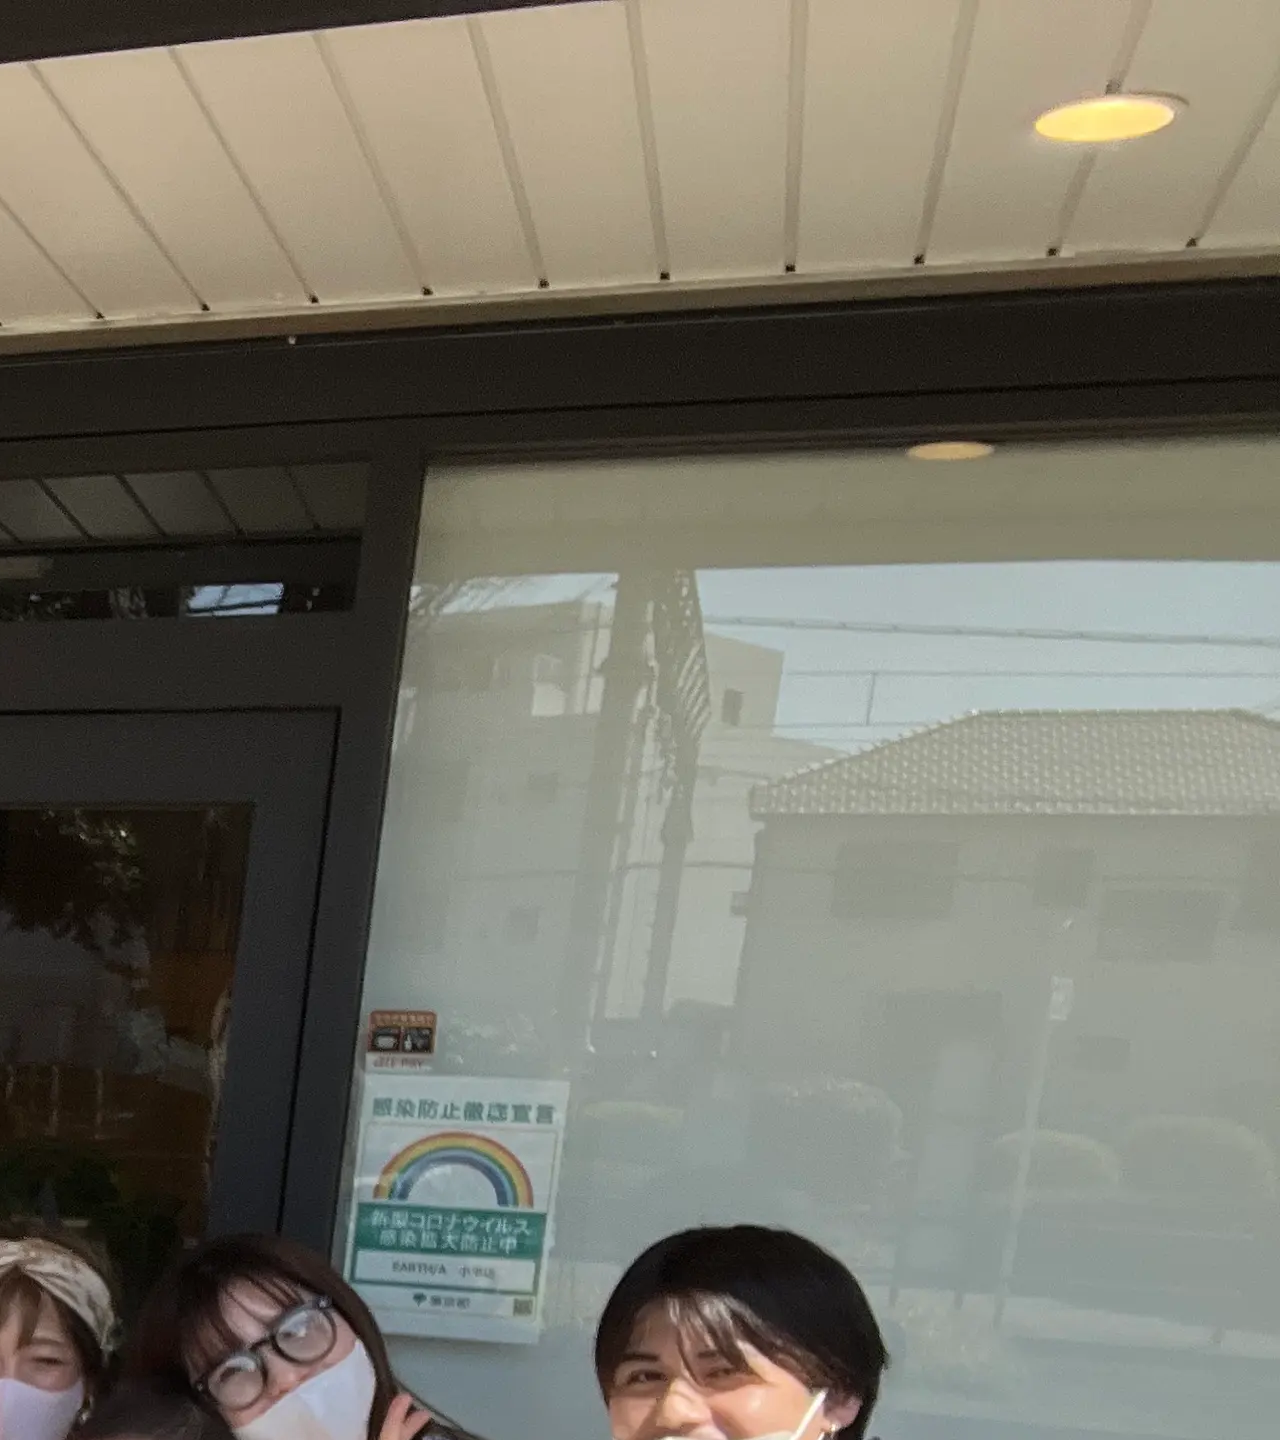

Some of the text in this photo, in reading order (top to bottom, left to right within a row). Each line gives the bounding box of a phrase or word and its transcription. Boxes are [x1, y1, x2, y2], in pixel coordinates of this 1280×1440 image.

[371, 1209, 532, 1235] 新型コロナウイルス
